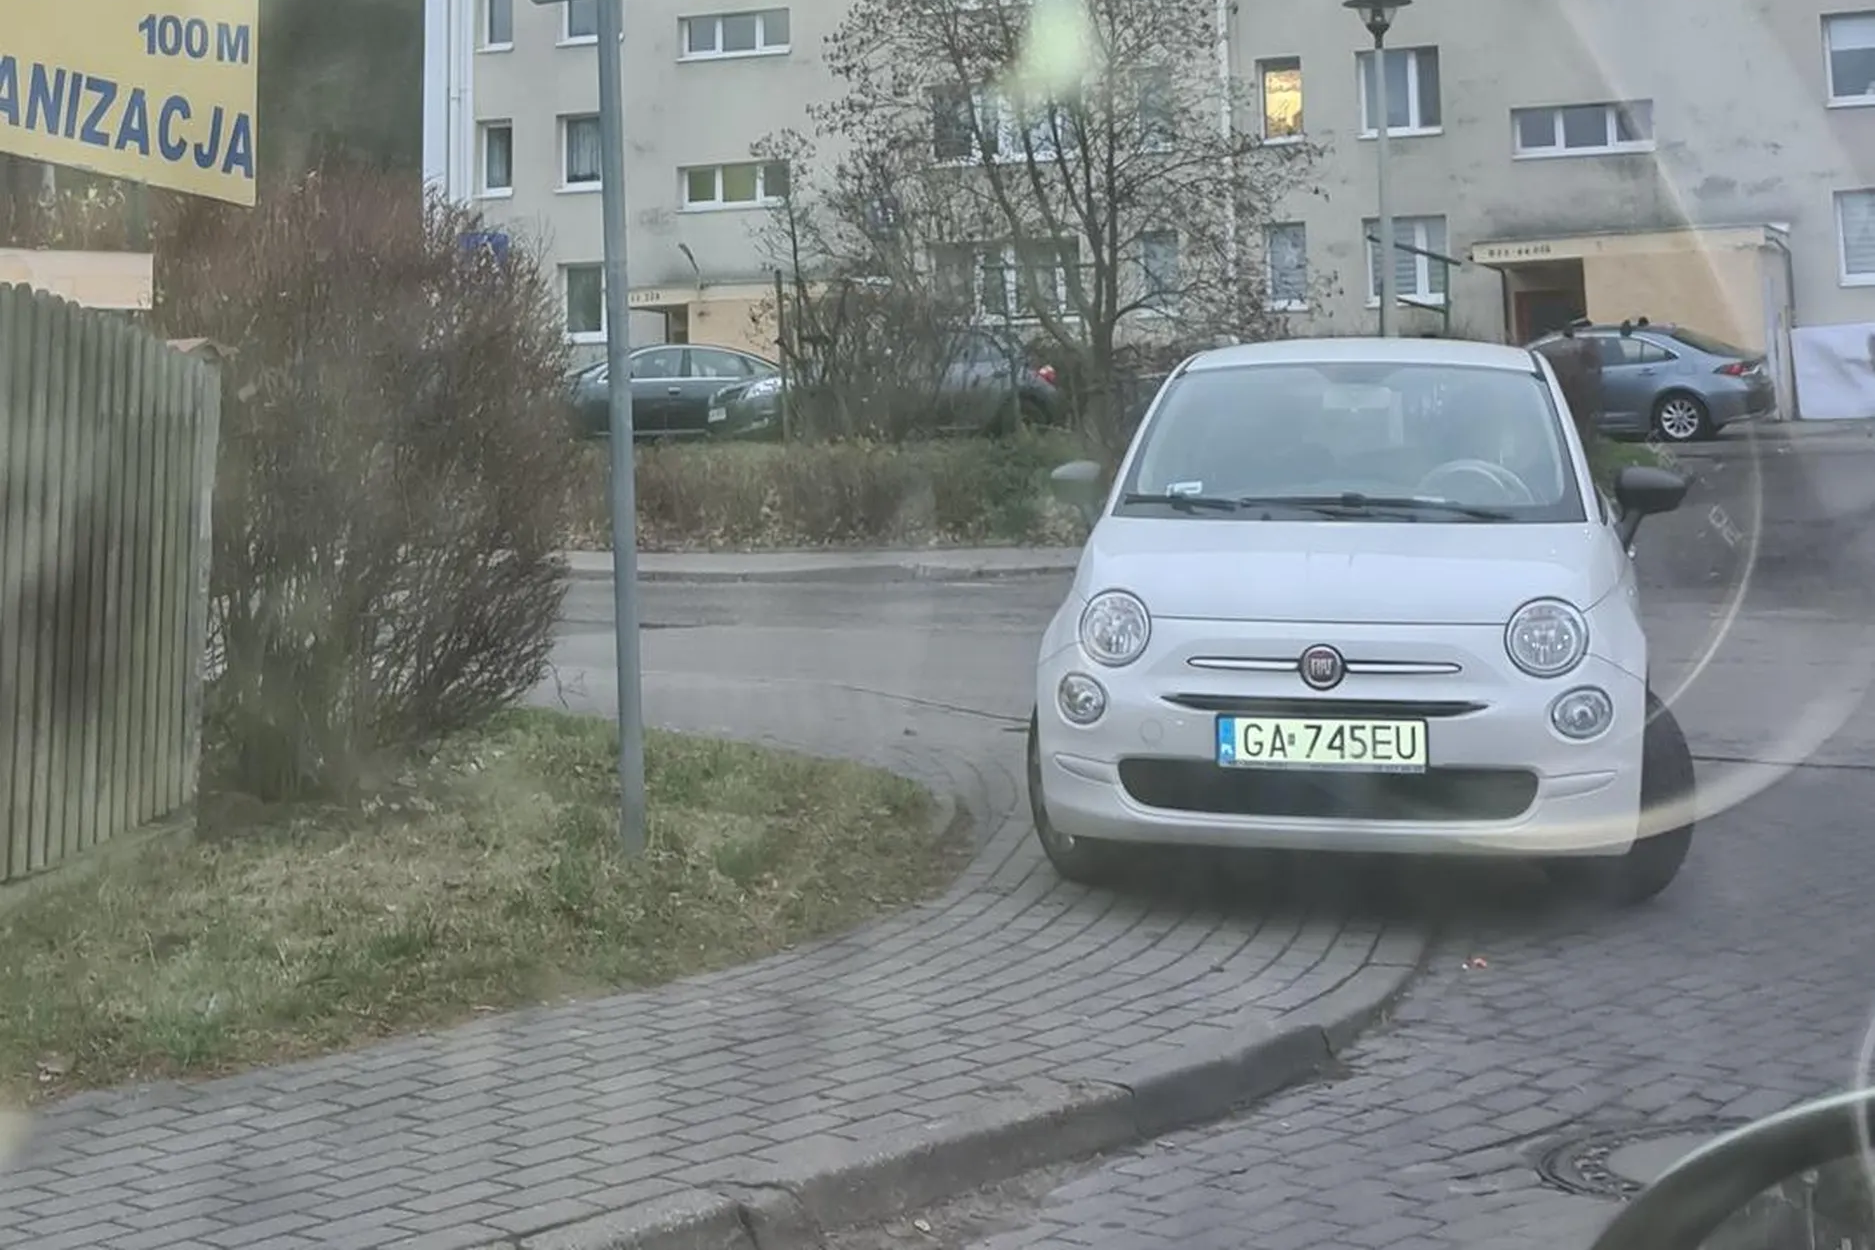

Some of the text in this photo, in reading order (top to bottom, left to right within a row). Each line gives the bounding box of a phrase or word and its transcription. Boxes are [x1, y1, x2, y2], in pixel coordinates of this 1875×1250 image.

[138, 13, 249, 64] 100 M
[0, 56, 254, 179] ANIZACJA
[1244, 723, 1417, 760] GA 745EU
